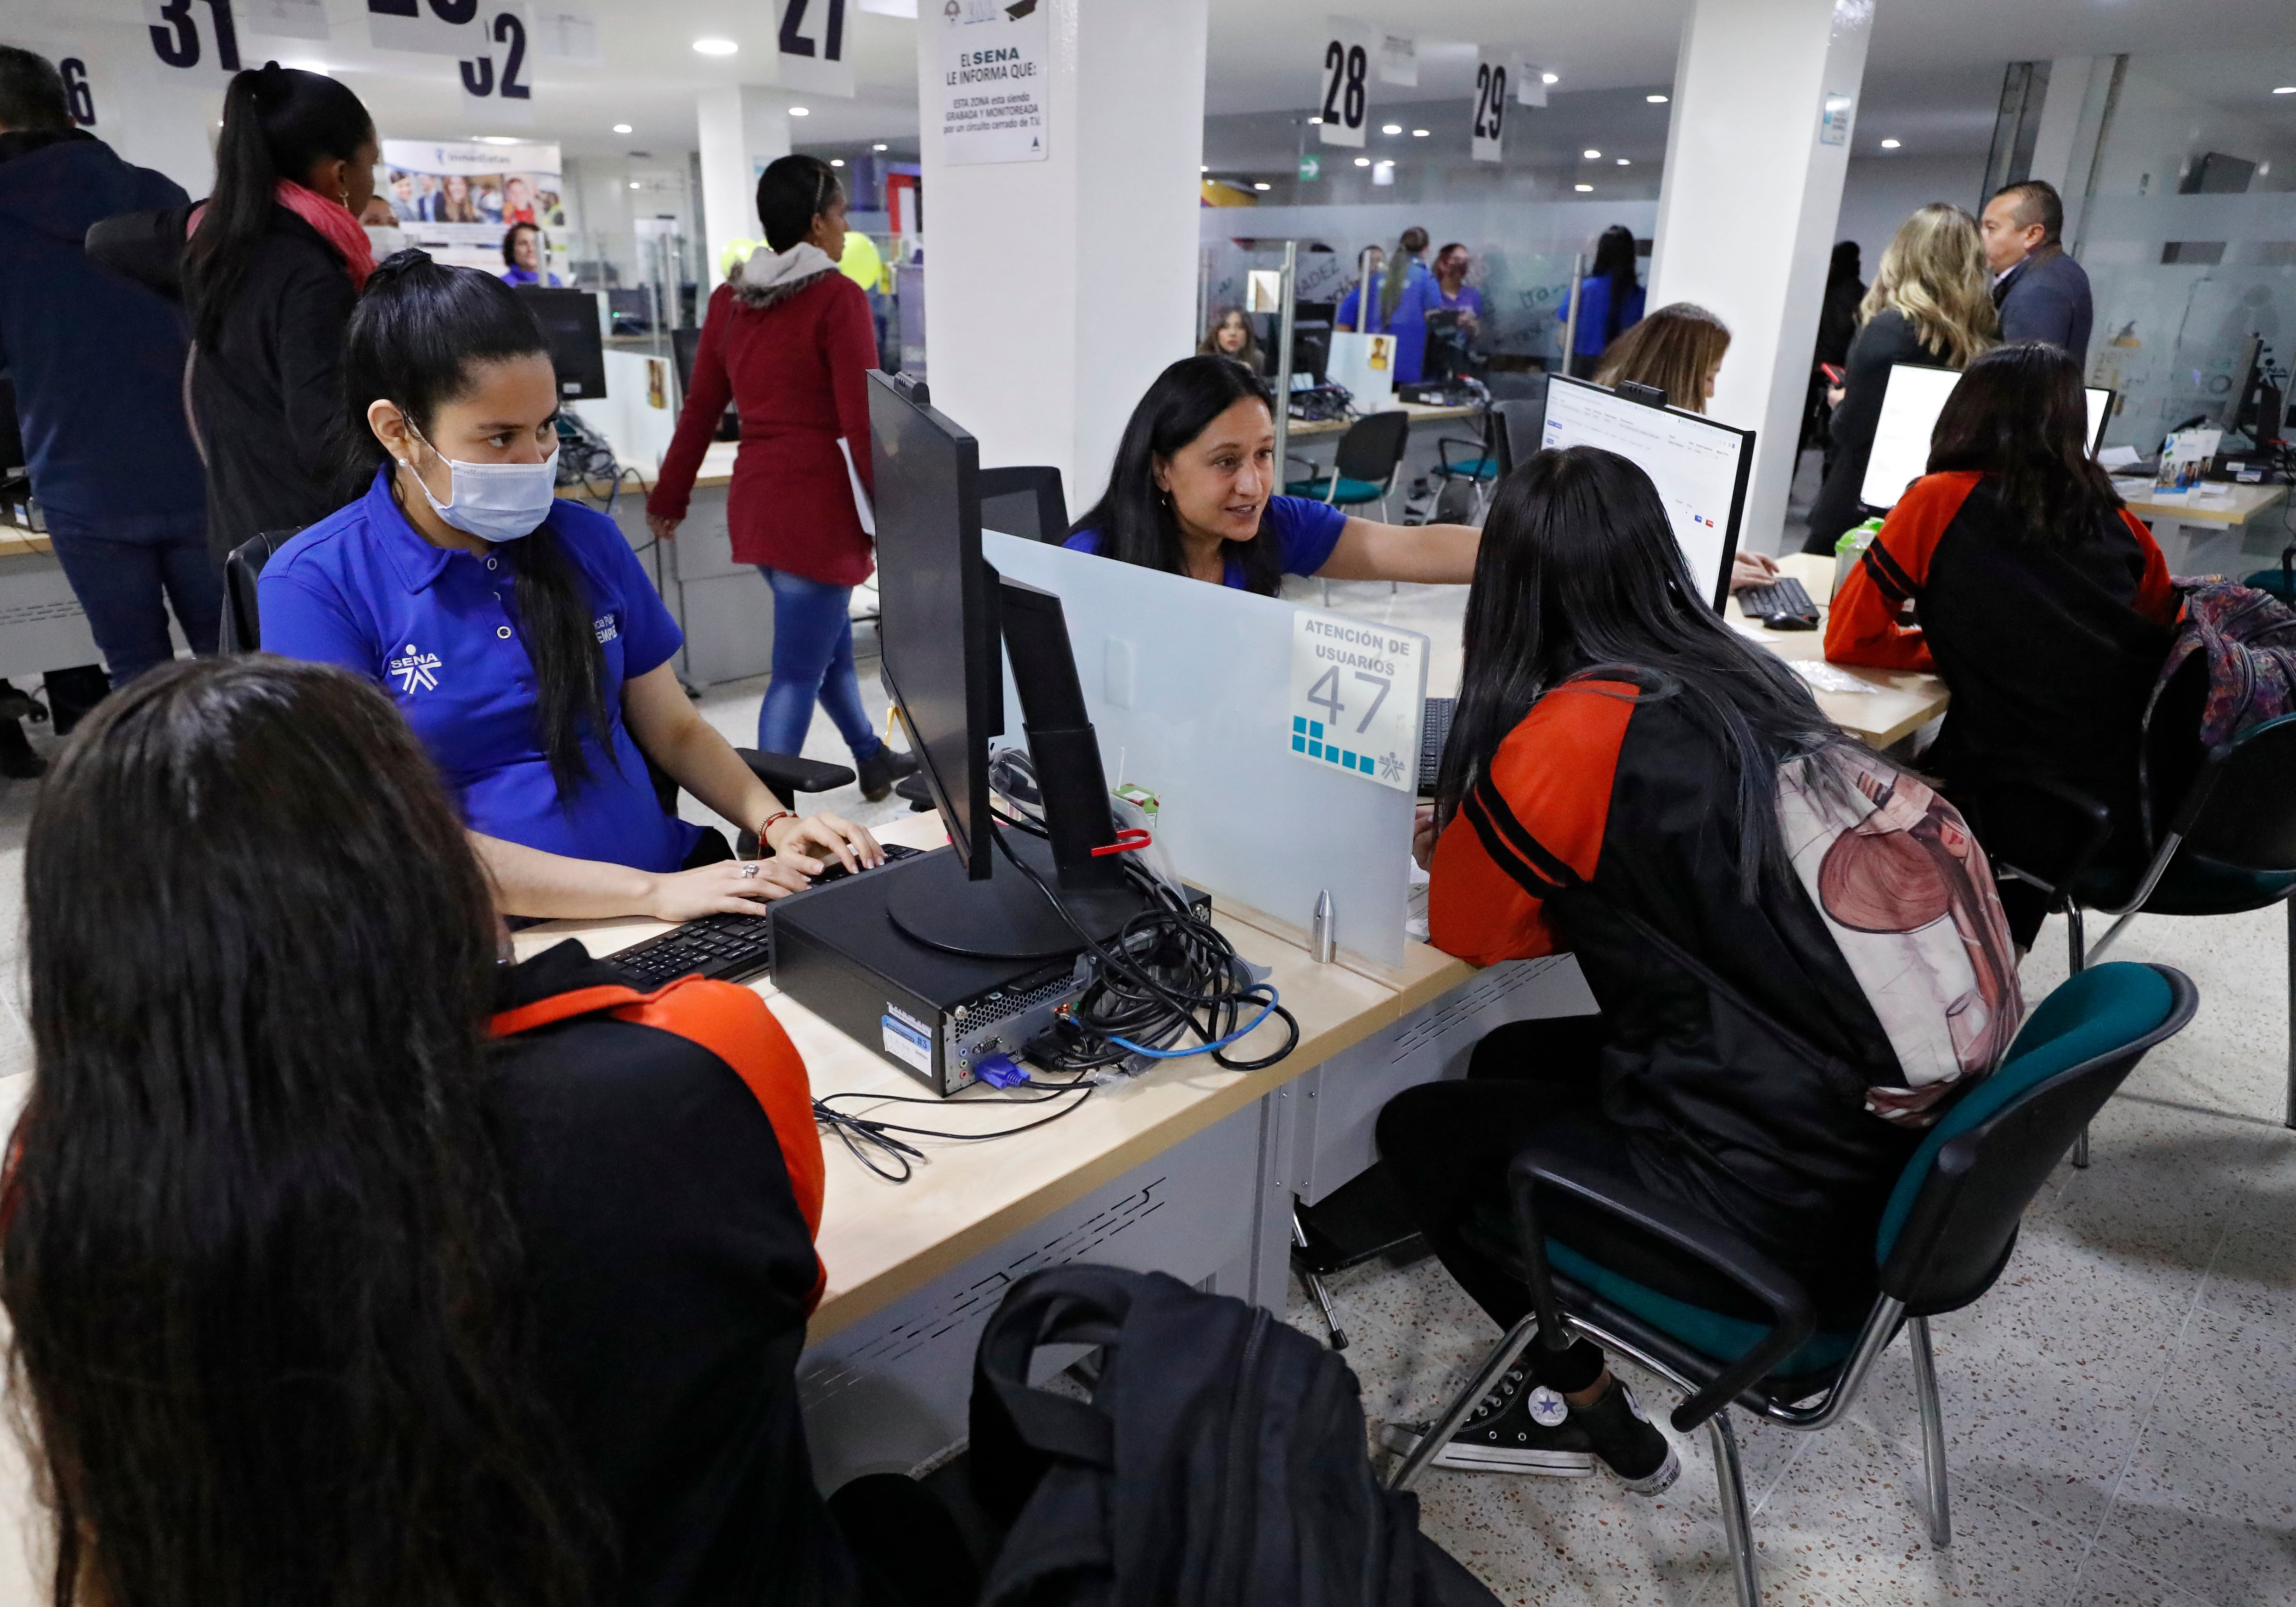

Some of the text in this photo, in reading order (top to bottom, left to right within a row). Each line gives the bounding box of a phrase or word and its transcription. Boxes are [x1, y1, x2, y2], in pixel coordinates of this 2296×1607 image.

[973, 47, 1020, 65] SENA
[946, 62, 1036, 85] LE INFORMA QUE:
[60, 57, 96, 125] 6
[1323, 40, 1367, 128] 28
[971, 96, 989, 107] ZONA
[1007, 93, 1030, 104] siendo
[1475, 62, 1506, 141] 29
[946, 104, 1039, 122] GRABADA Y MONITOREADA
[944, 126, 954, 135] por
[966, 121, 990, 132] circuito
[992, 119, 1018, 130] cerrado
[1019, 118, 1028, 127] de
[1305, 620, 1410, 656] ATENCIÓN DE
[391, 653, 439, 668] SENA
[1316, 645, 1395, 677] USUARIOS
[1307, 665, 1390, 734] 47
[1379, 755, 1406, 767] SENA
[917, 1037, 927, 1049] #3
